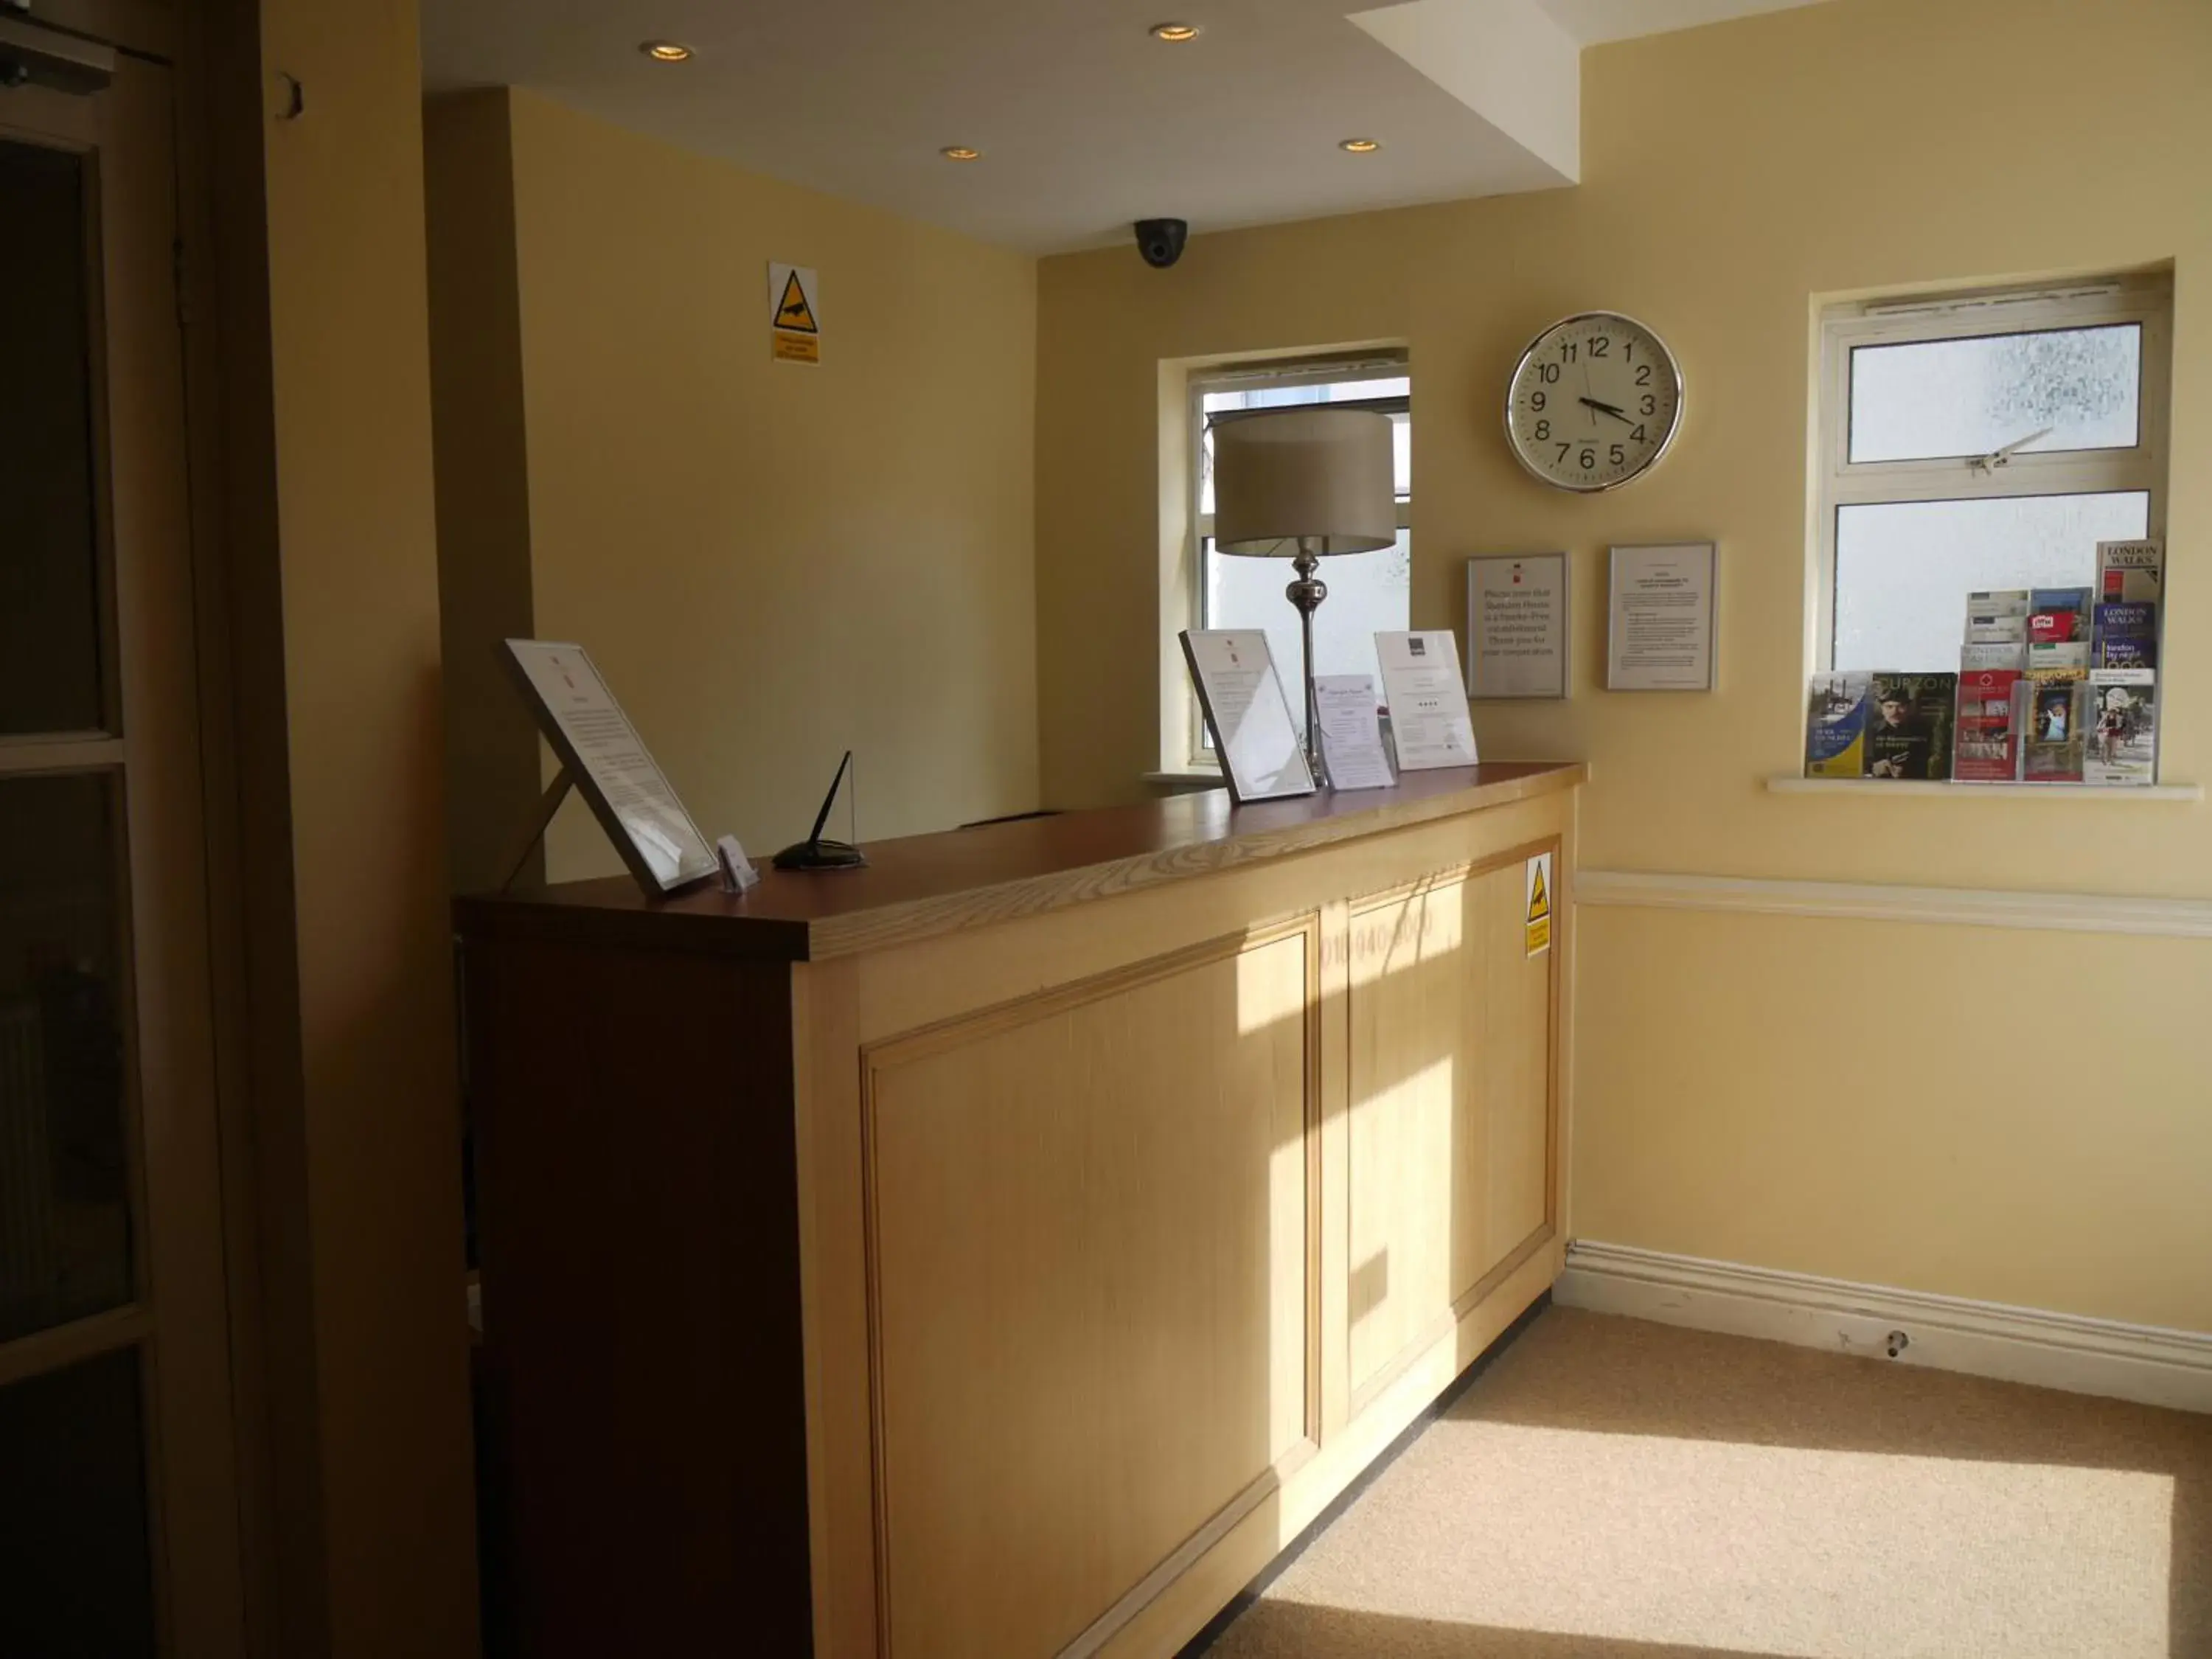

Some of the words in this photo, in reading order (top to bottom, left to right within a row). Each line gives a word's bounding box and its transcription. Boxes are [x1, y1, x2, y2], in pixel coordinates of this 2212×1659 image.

[1560, 344, 1577, 364] 11
[1587, 336, 1609, 358] 12
[1623, 343, 1632, 363] 1
[1538, 364, 1560, 383] 10
[1635, 365, 1651, 386] 2
[1531, 392, 1546, 412] 9
[1640, 394, 1655, 416] 3
[1534, 420, 1551, 441] 8
[1630, 424, 1646, 444] 4
[1556, 443, 1571, 463] 7
[1580, 448, 1595, 469] 6
[1610, 445, 1624, 465] 5
[2107, 546, 2157, 556] LONDON
[2111, 555, 2154, 565] WALKS
[2104, 607, 2147, 616] LONDON
[2107, 616, 2143, 625] WALKS
